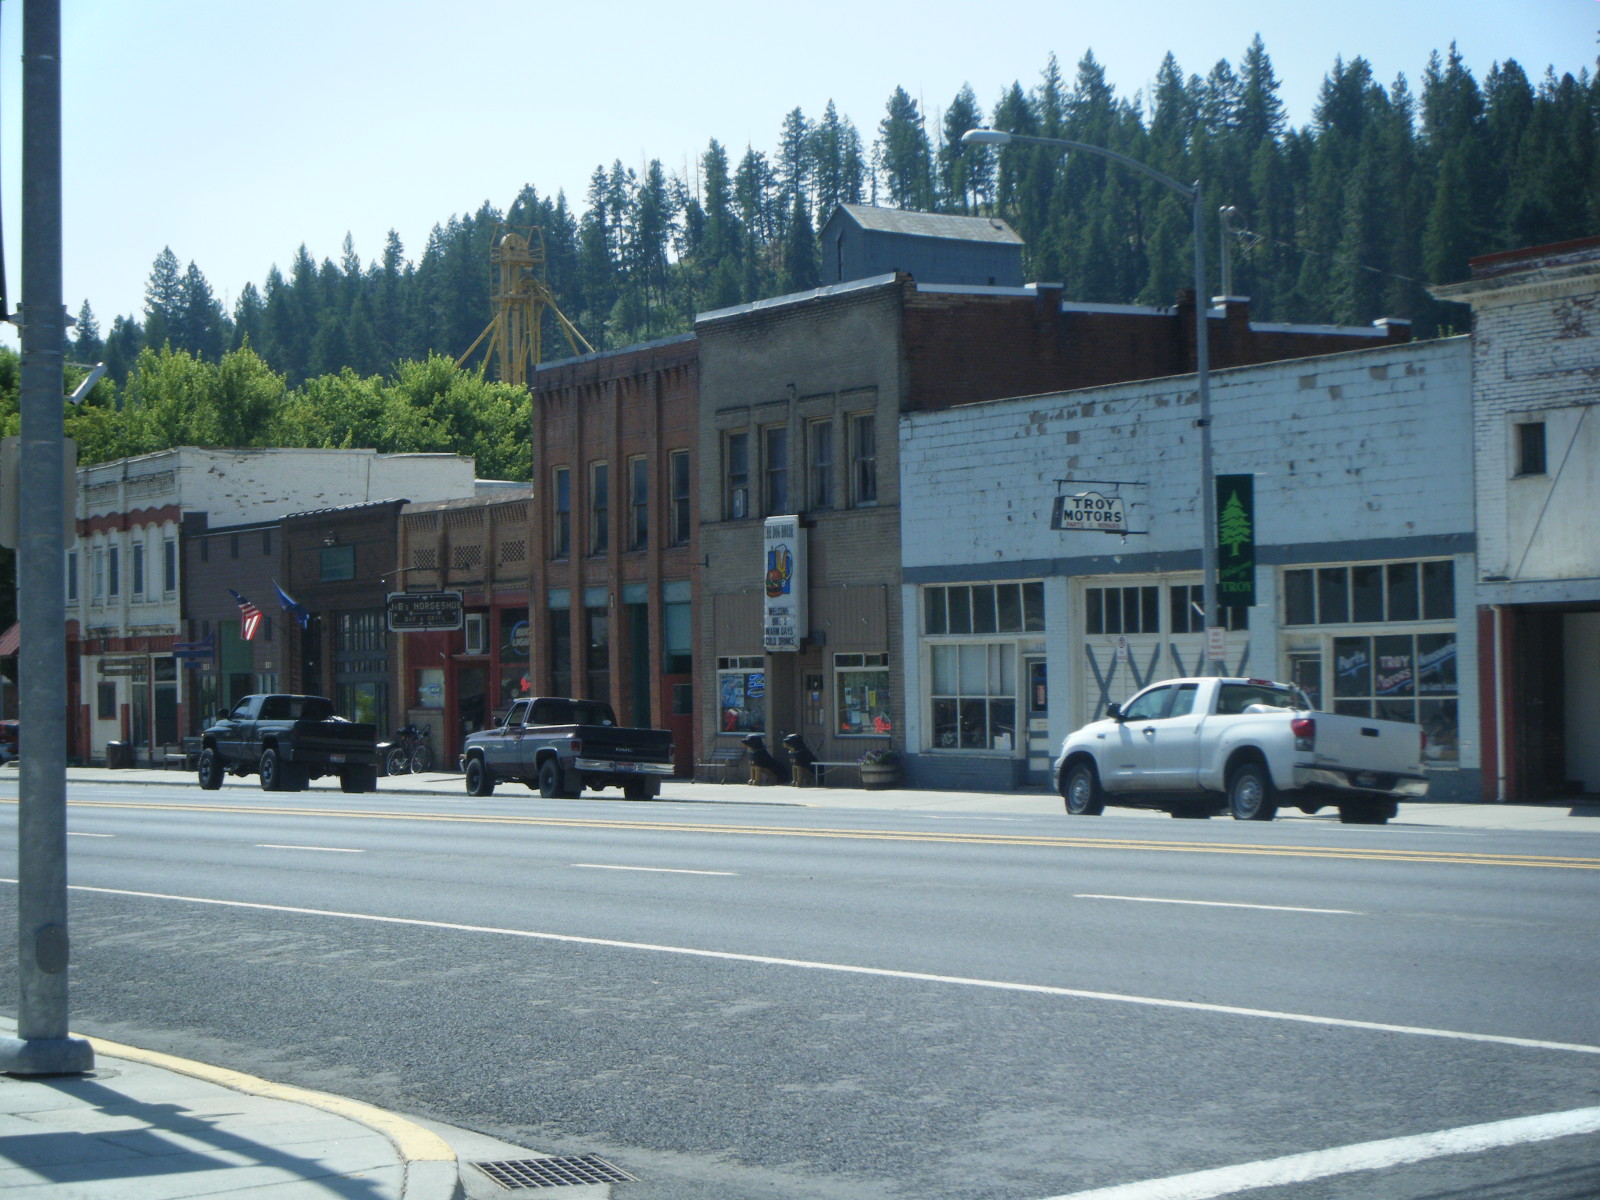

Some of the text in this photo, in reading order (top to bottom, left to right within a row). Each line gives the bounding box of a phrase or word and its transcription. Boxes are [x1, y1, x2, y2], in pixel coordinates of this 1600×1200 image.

[1073, 499, 1114, 510] TROY
[1064, 510, 1122, 522] MOTORS
[1220, 581, 1251, 592] TROY
[413, 601, 462, 611] HORSESHOE
[768, 607, 789, 616] WELCOME
[765, 626, 794, 636] WARM DAYS
[765, 637, 795, 646] COLD DRINKS
[1379, 656, 1410, 668] TROY
